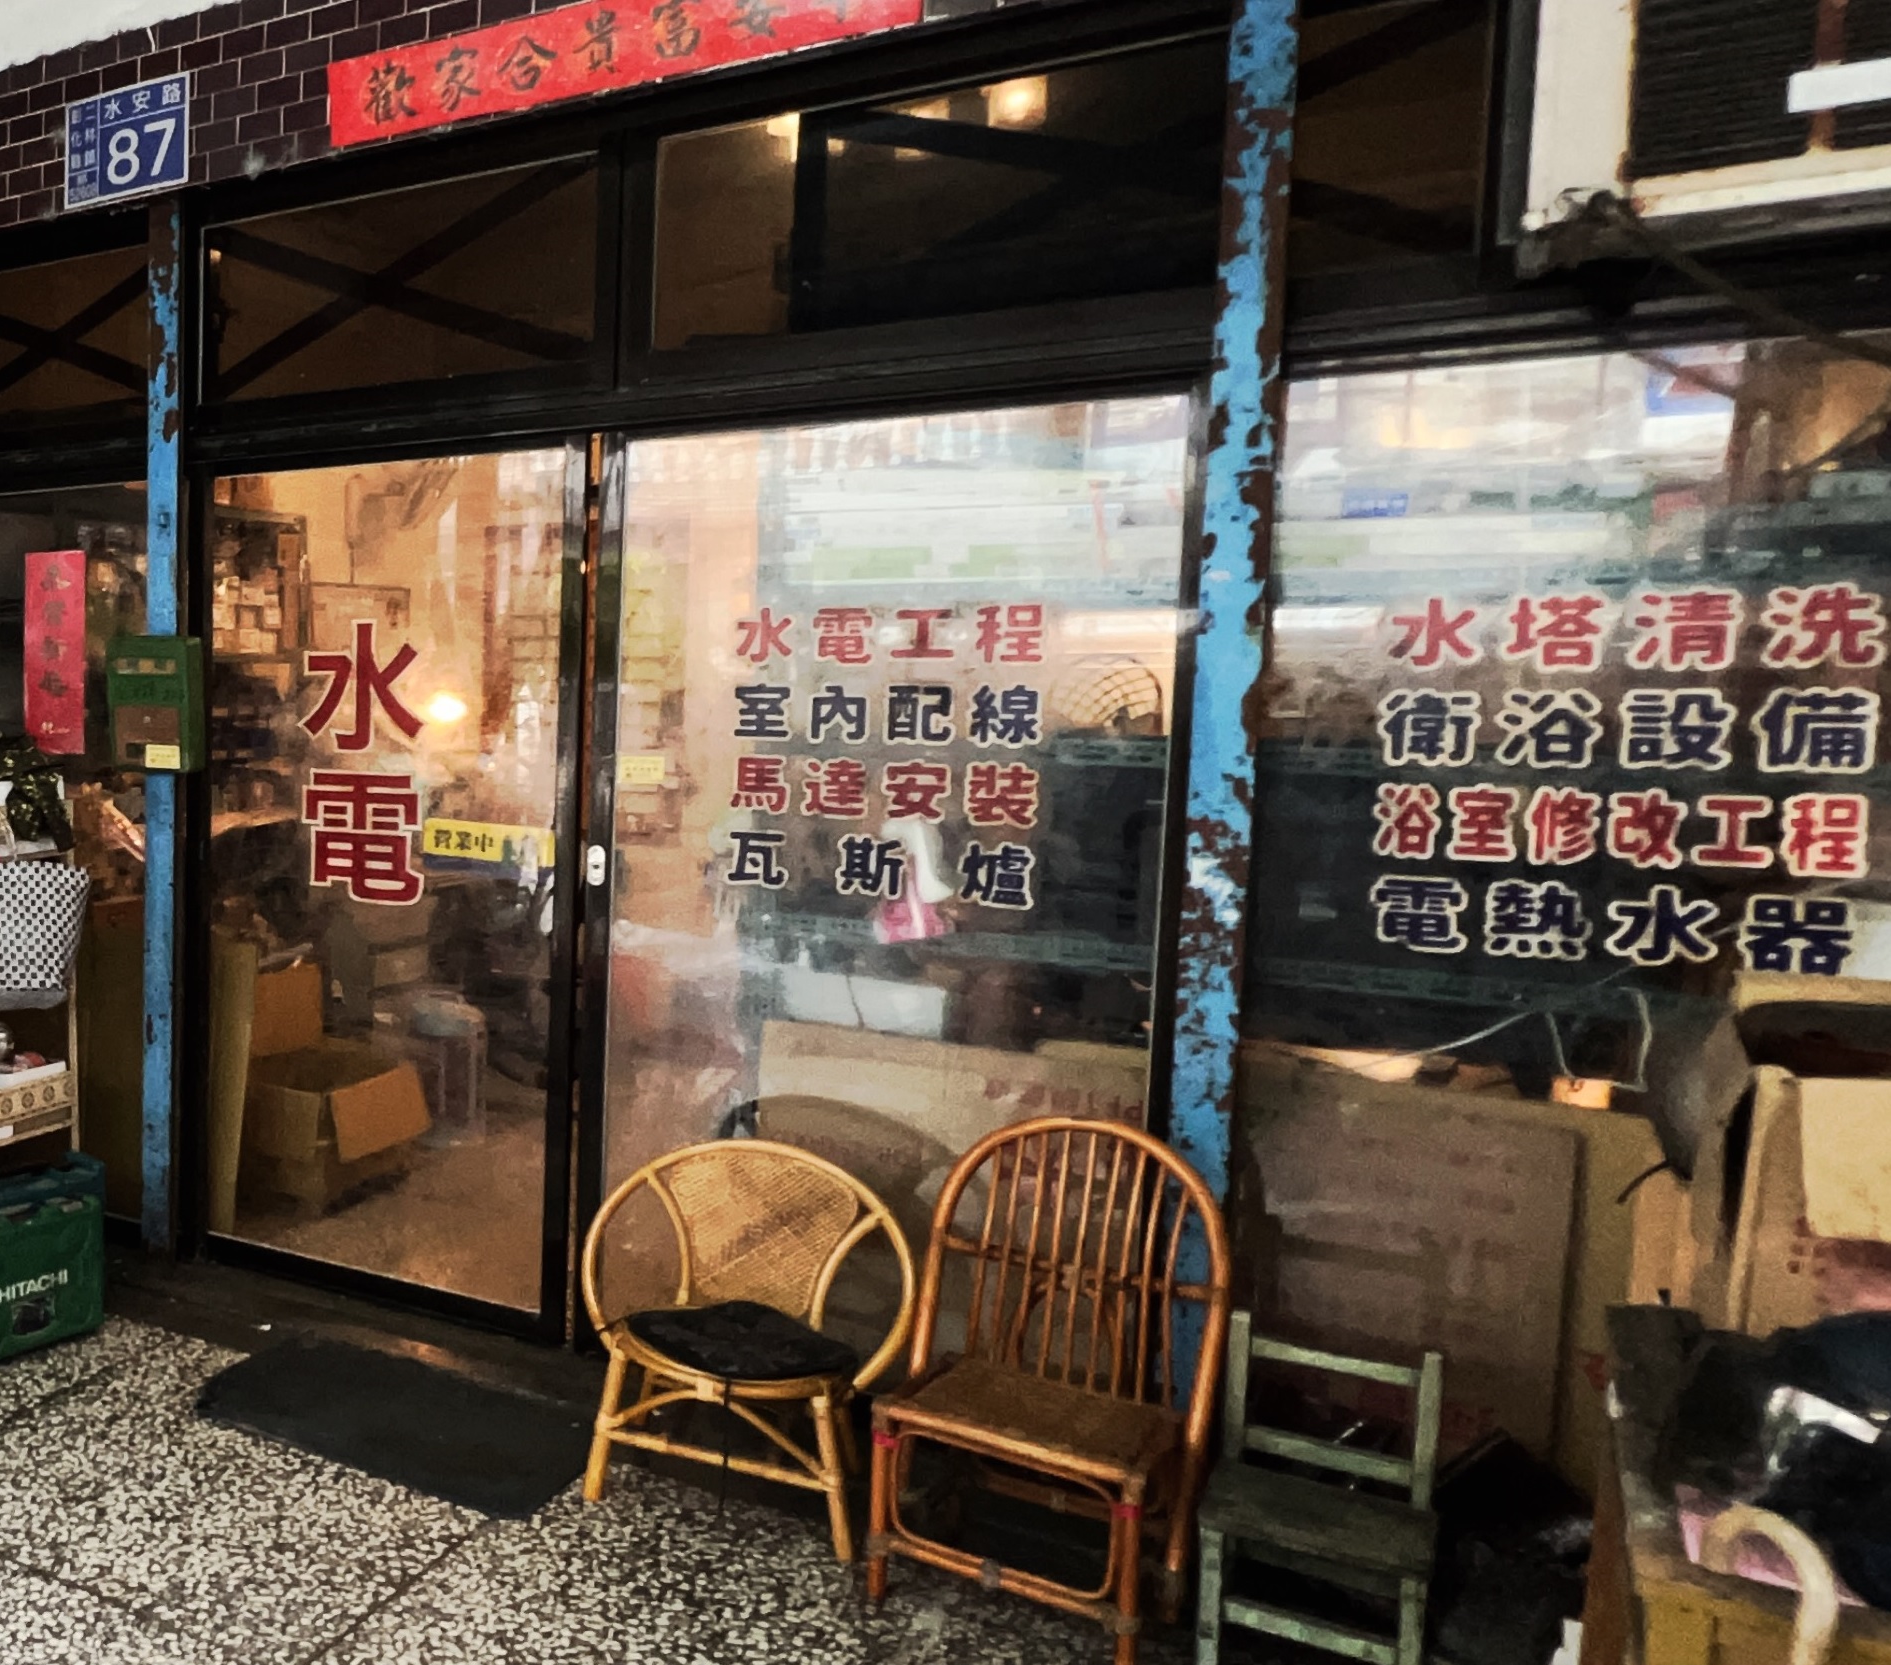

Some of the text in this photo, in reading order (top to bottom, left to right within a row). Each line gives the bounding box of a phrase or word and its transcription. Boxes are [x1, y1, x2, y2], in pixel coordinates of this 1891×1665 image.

[107, 118, 176, 185] 87
[734, 603, 1045, 665] 水電工程
[1385, 583, 1888, 671] 水塔清洗
[733, 683, 1041, 748] 室內配線
[1378, 687, 1881, 774] 衛浴設備
[298, 618, 428, 906] 水電
[729, 756, 1040, 828] 馬達安裝
[727, 830, 1036, 909] 瓦斯爐
[1373, 782, 1868, 878] 浴室修改工程
[1371, 873, 1855, 976] 電熱水器
